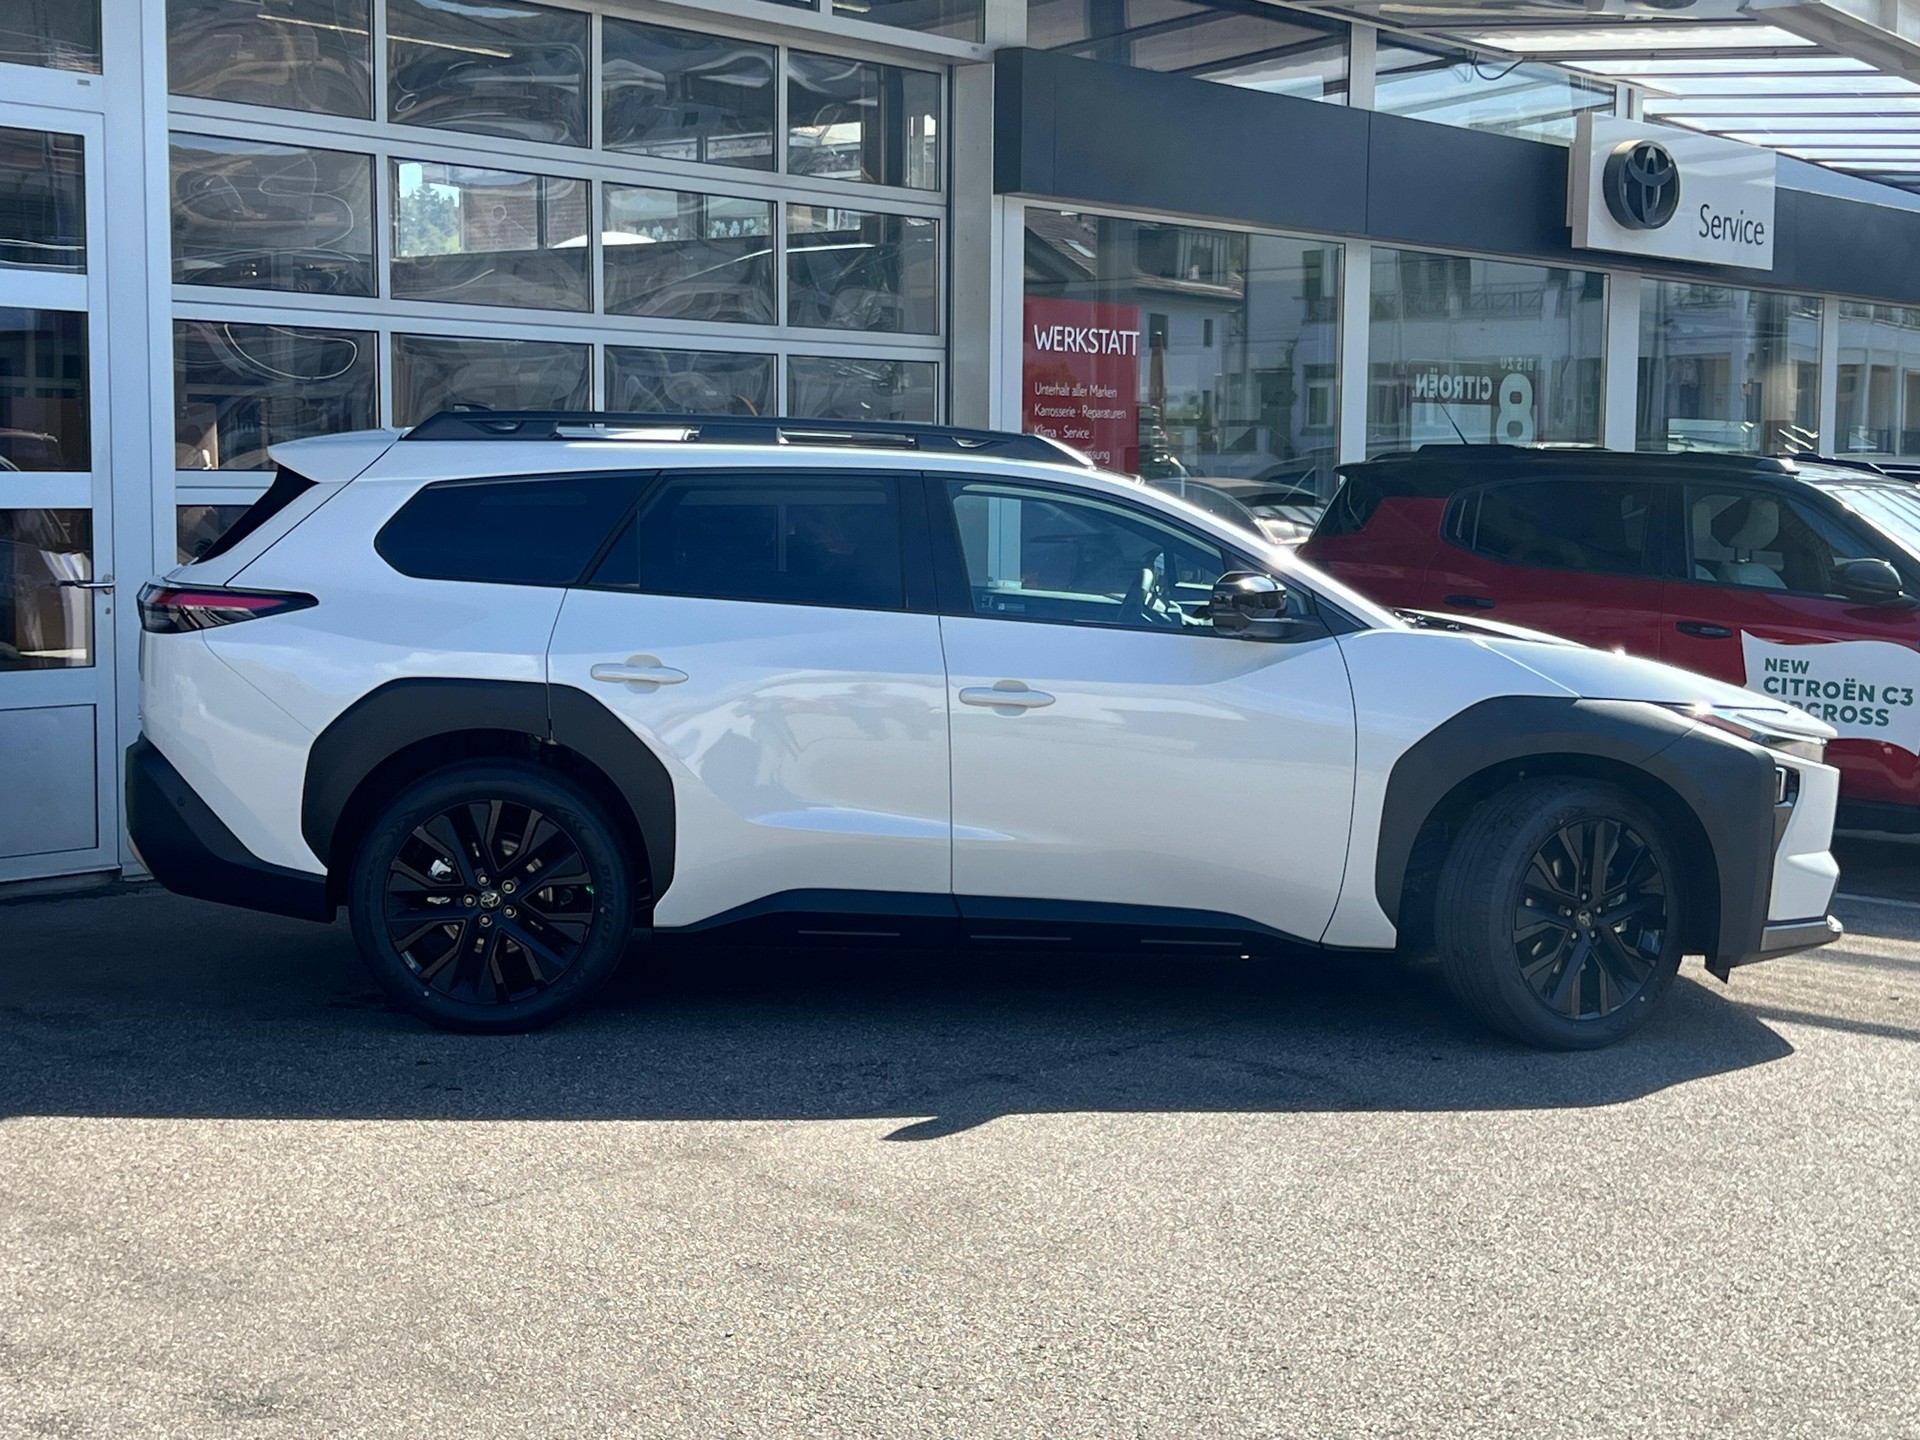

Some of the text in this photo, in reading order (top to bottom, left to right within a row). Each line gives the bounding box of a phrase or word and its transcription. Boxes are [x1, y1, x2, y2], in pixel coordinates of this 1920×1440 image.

[1698, 203, 1765, 246] Service
[1033, 324, 1140, 356] WERKSTATT
[1034, 381, 1118, 398] Unterhalt aller Marken
[1063, 424, 1090, 439] Service
[1764, 657, 1810, 675] NEW
[1763, 676, 1914, 706] CITROËN C3
[1784, 699, 1890, 727] CROSS
